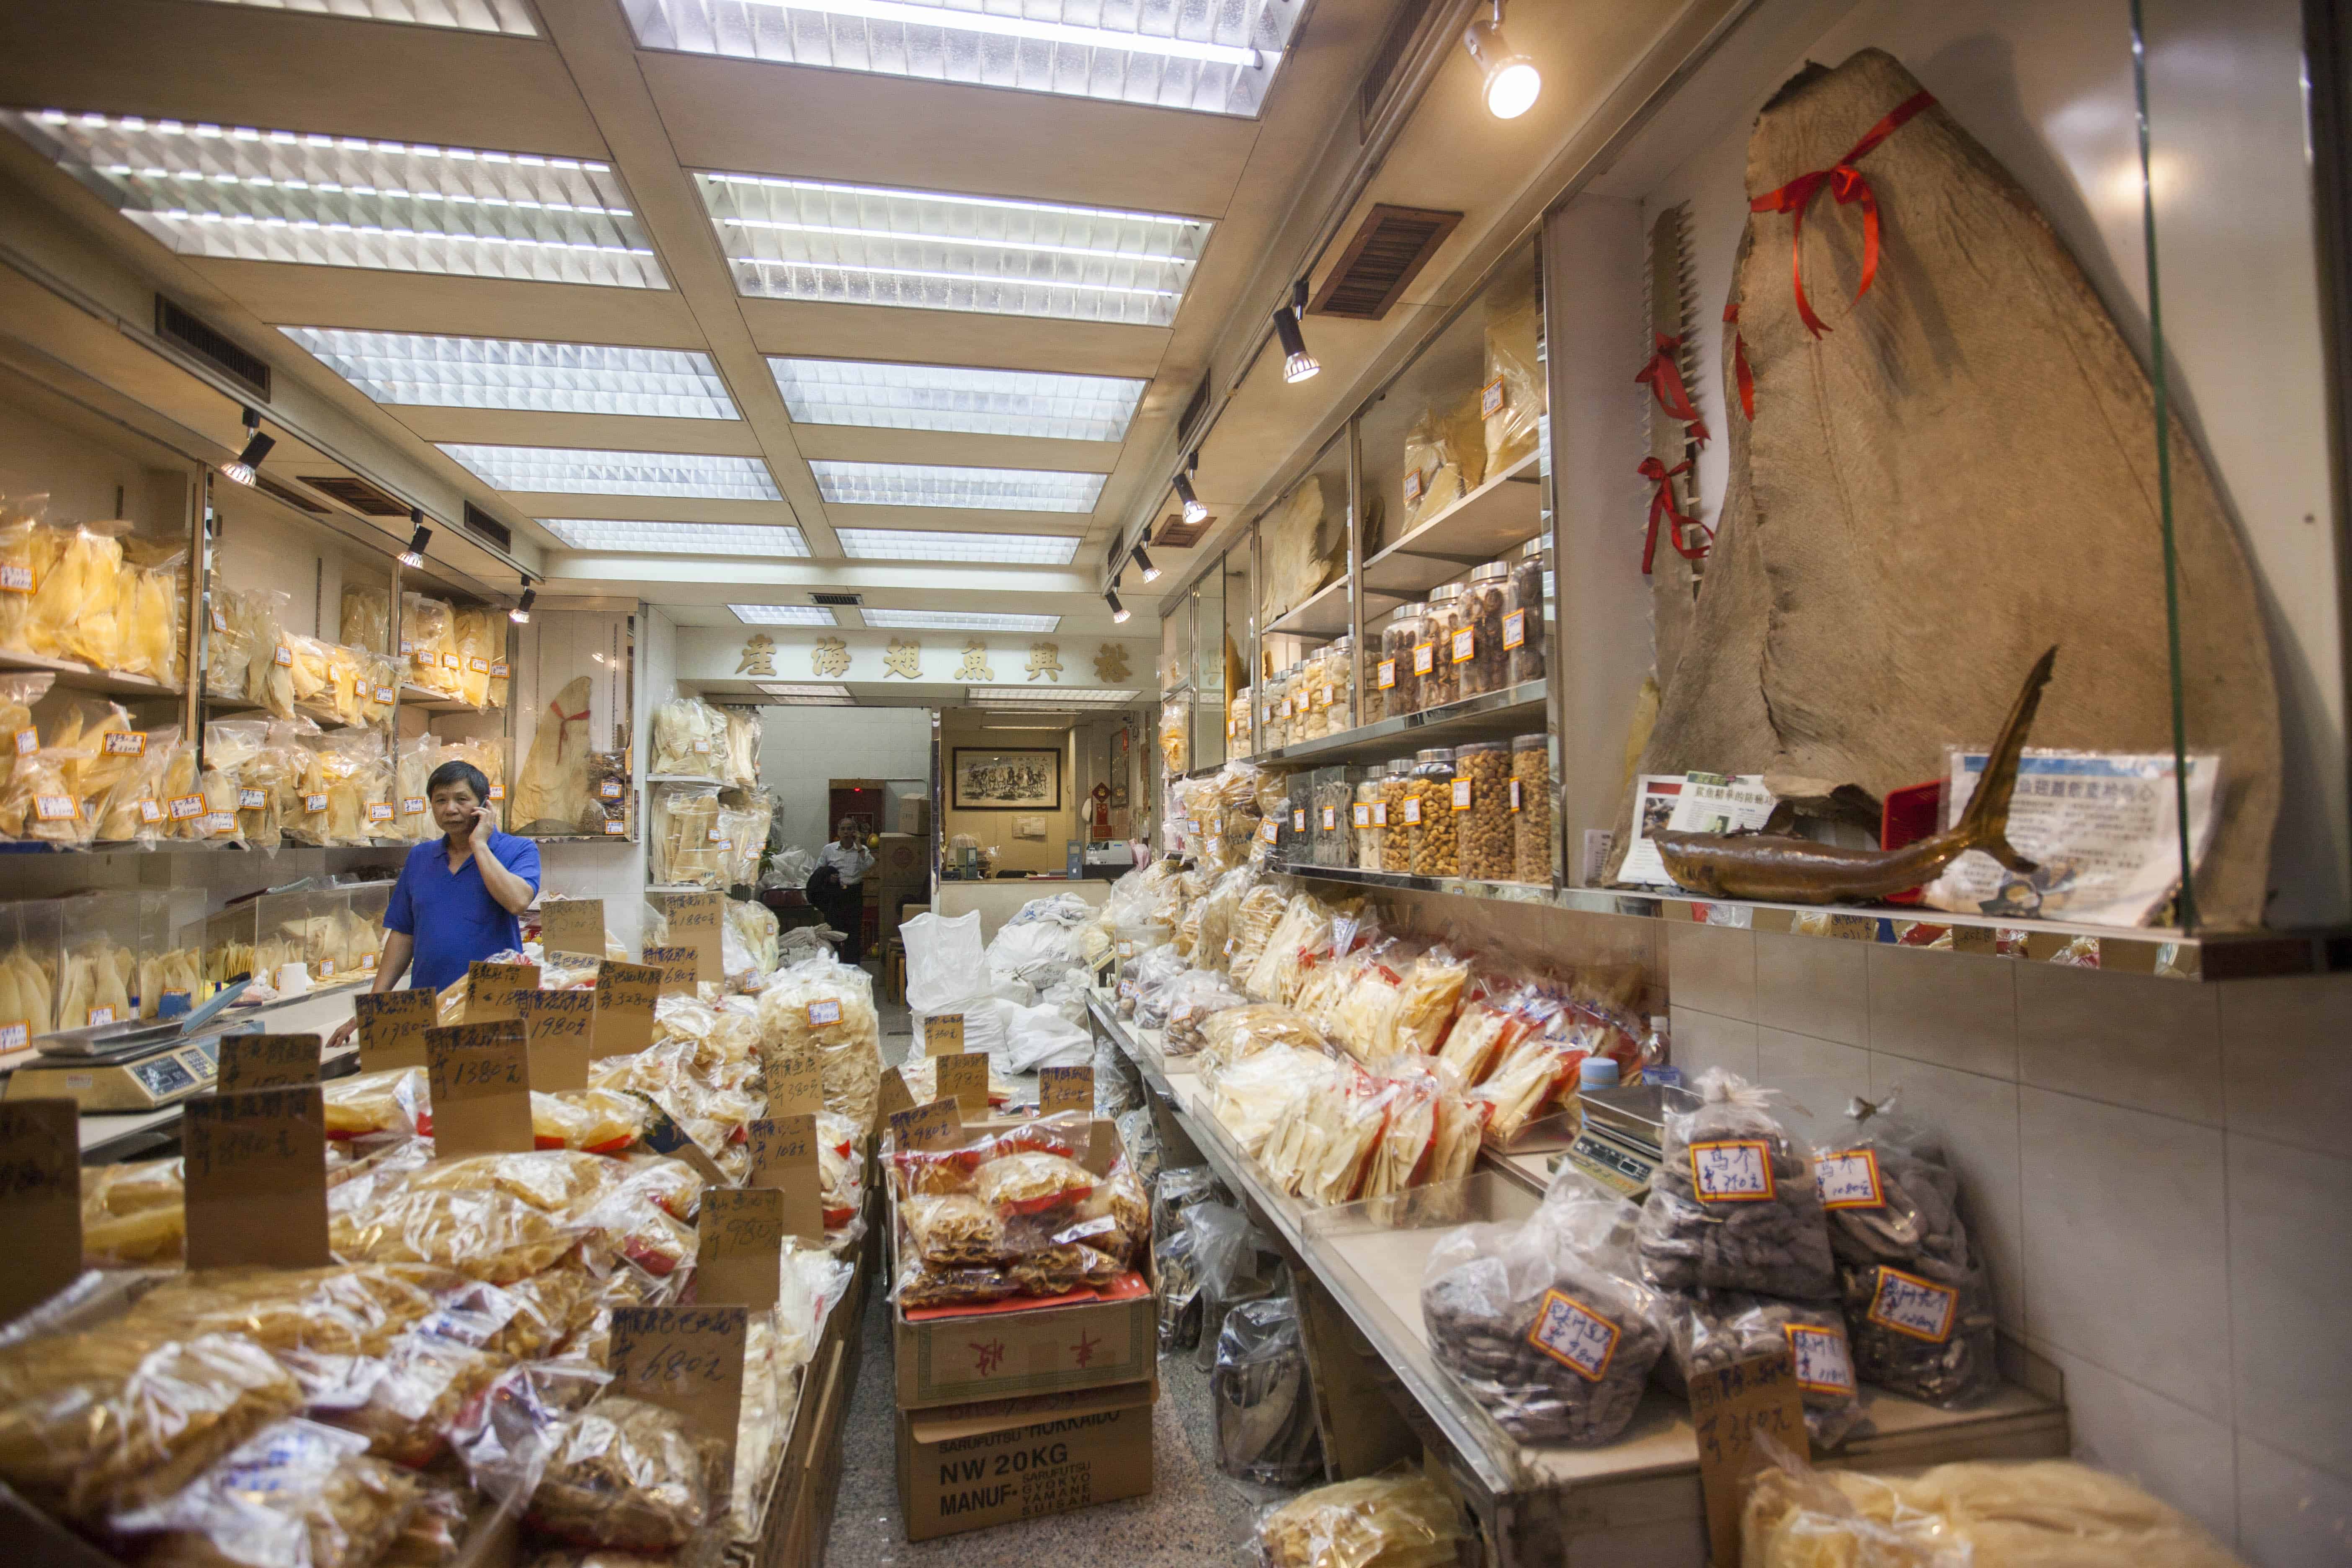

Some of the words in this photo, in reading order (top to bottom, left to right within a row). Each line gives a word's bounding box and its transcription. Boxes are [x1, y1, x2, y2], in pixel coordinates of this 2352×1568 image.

[531, 1016, 586, 1039] 1980元
[939, 1429, 1021, 1454] SARUFUTSU
[940, 1458, 985, 1485] NW
[995, 1443, 1068, 1476] 20KG
[1022, 1461, 1091, 1483] SARUFUTSU
[1022, 1473, 1091, 1495] GYOKYO
[1022, 1484, 1091, 1505] YAMANE
[1022, 1494, 1091, 1516] SUISAN
